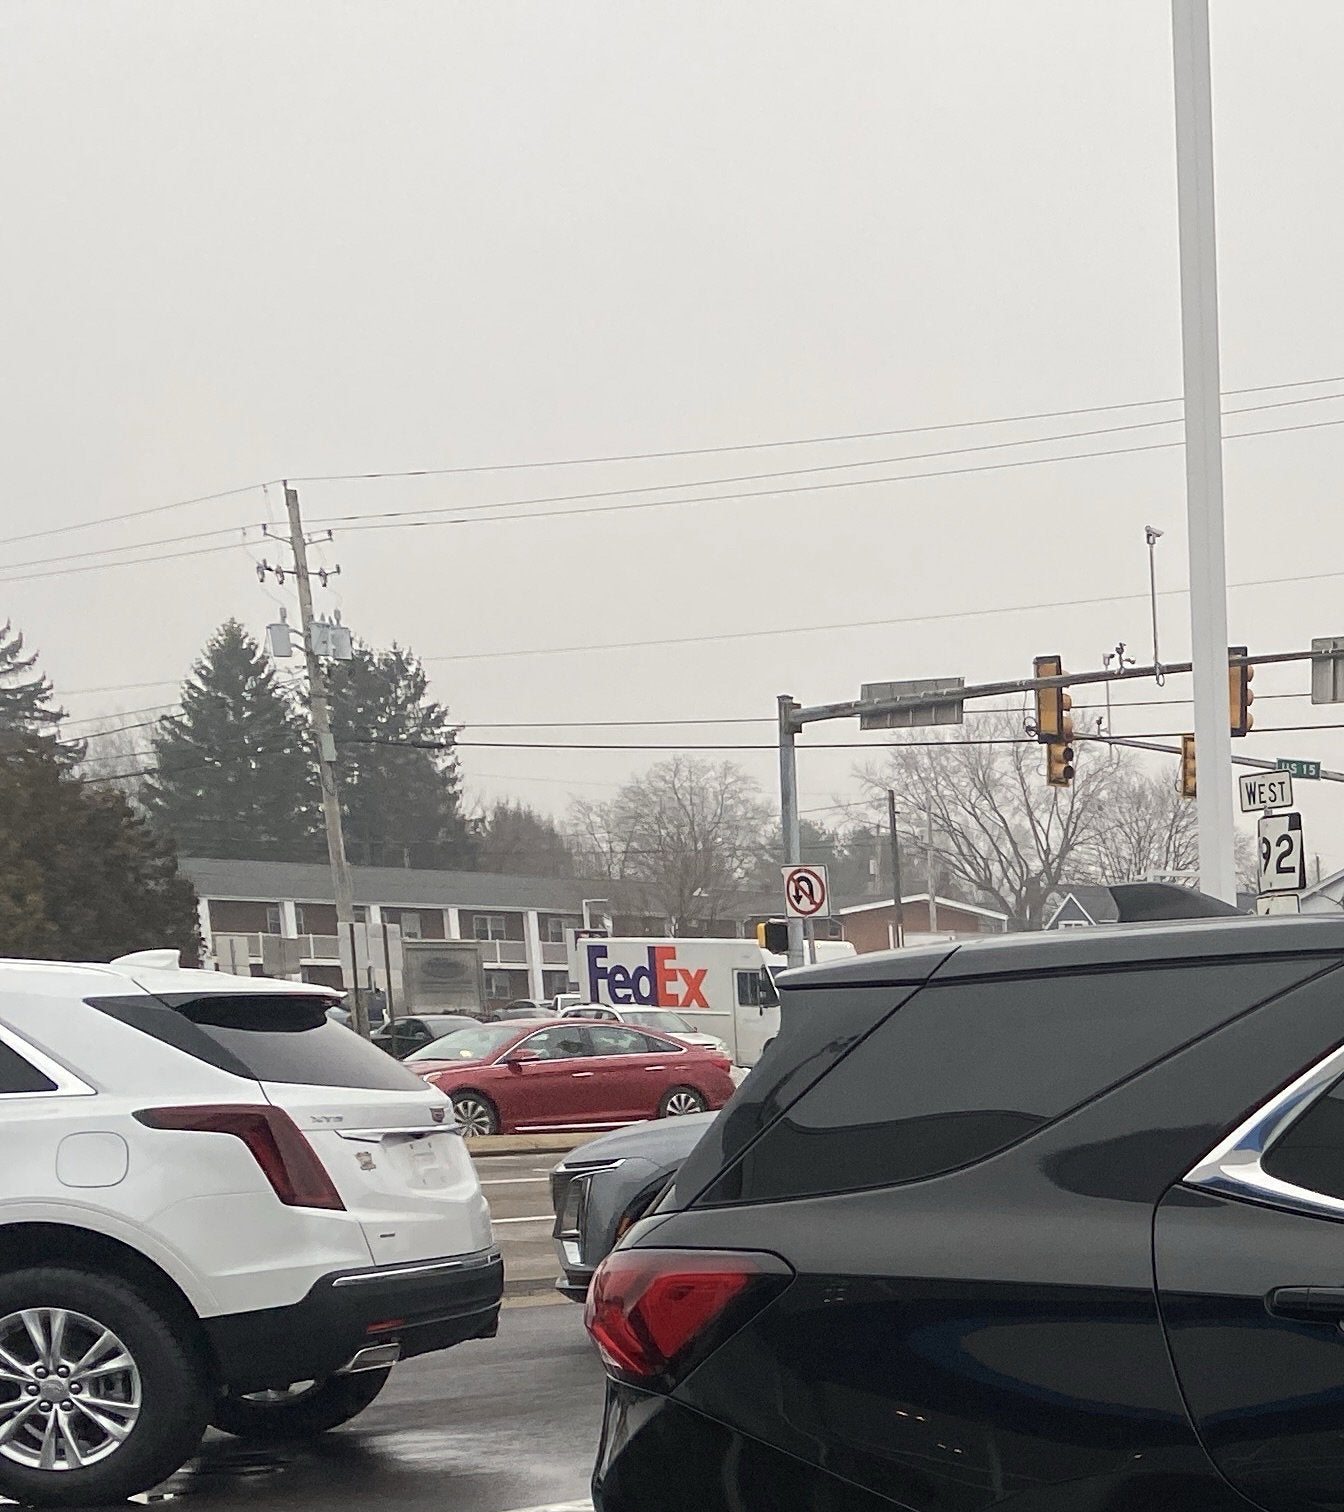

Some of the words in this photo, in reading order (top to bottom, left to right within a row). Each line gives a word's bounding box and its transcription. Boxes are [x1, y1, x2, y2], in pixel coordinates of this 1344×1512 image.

[1302, 764, 1317, 776] 15
[1245, 781, 1286, 806] WEST
[587, 944, 710, 1009] FedEx
